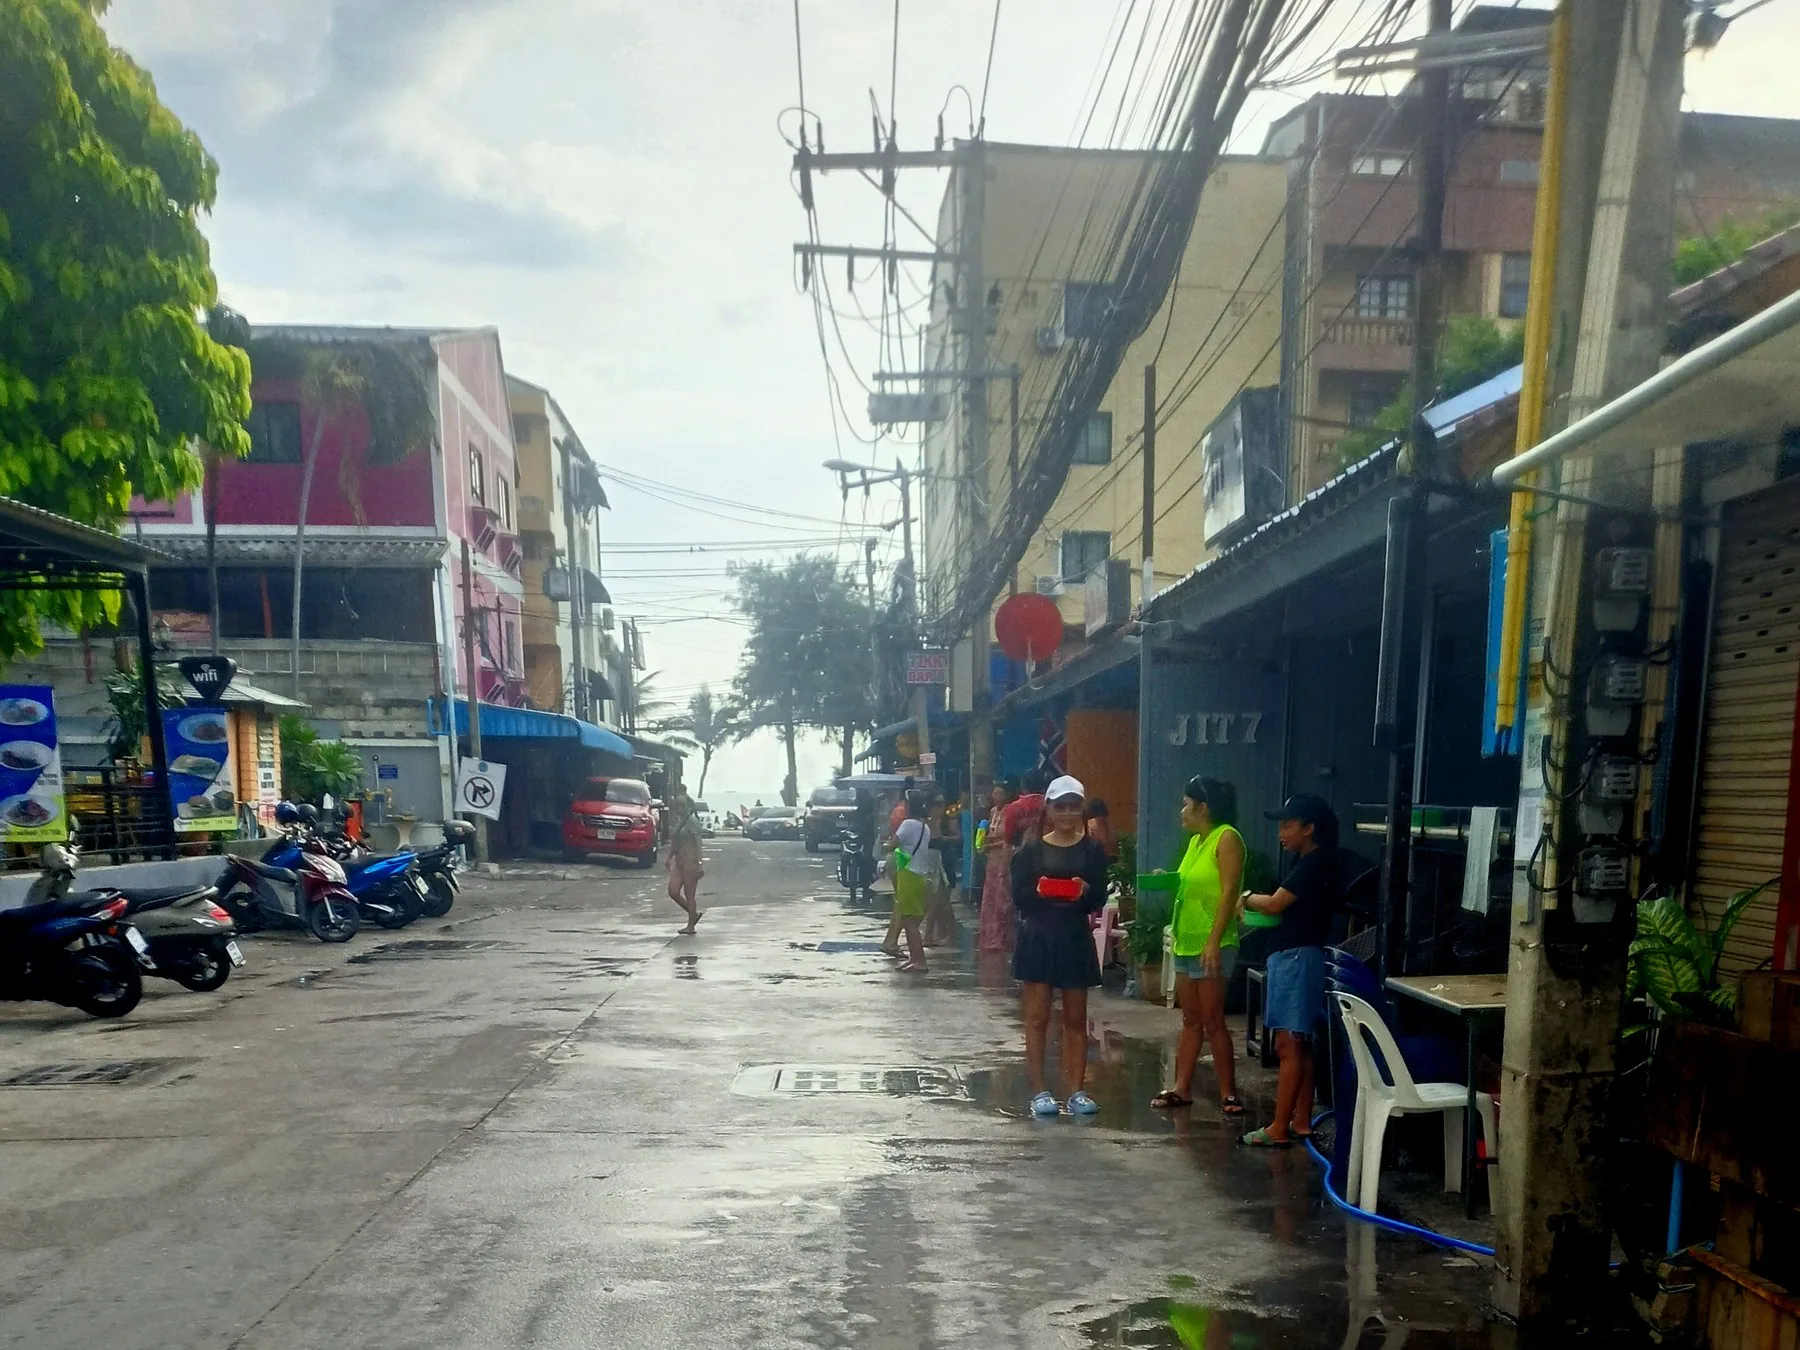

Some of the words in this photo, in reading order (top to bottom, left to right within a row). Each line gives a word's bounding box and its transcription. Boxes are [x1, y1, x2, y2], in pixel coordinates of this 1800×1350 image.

[192, 668, 218, 682] wifi
[1169, 712, 1236, 746] JIT
[1242, 711, 1263, 744] 7
